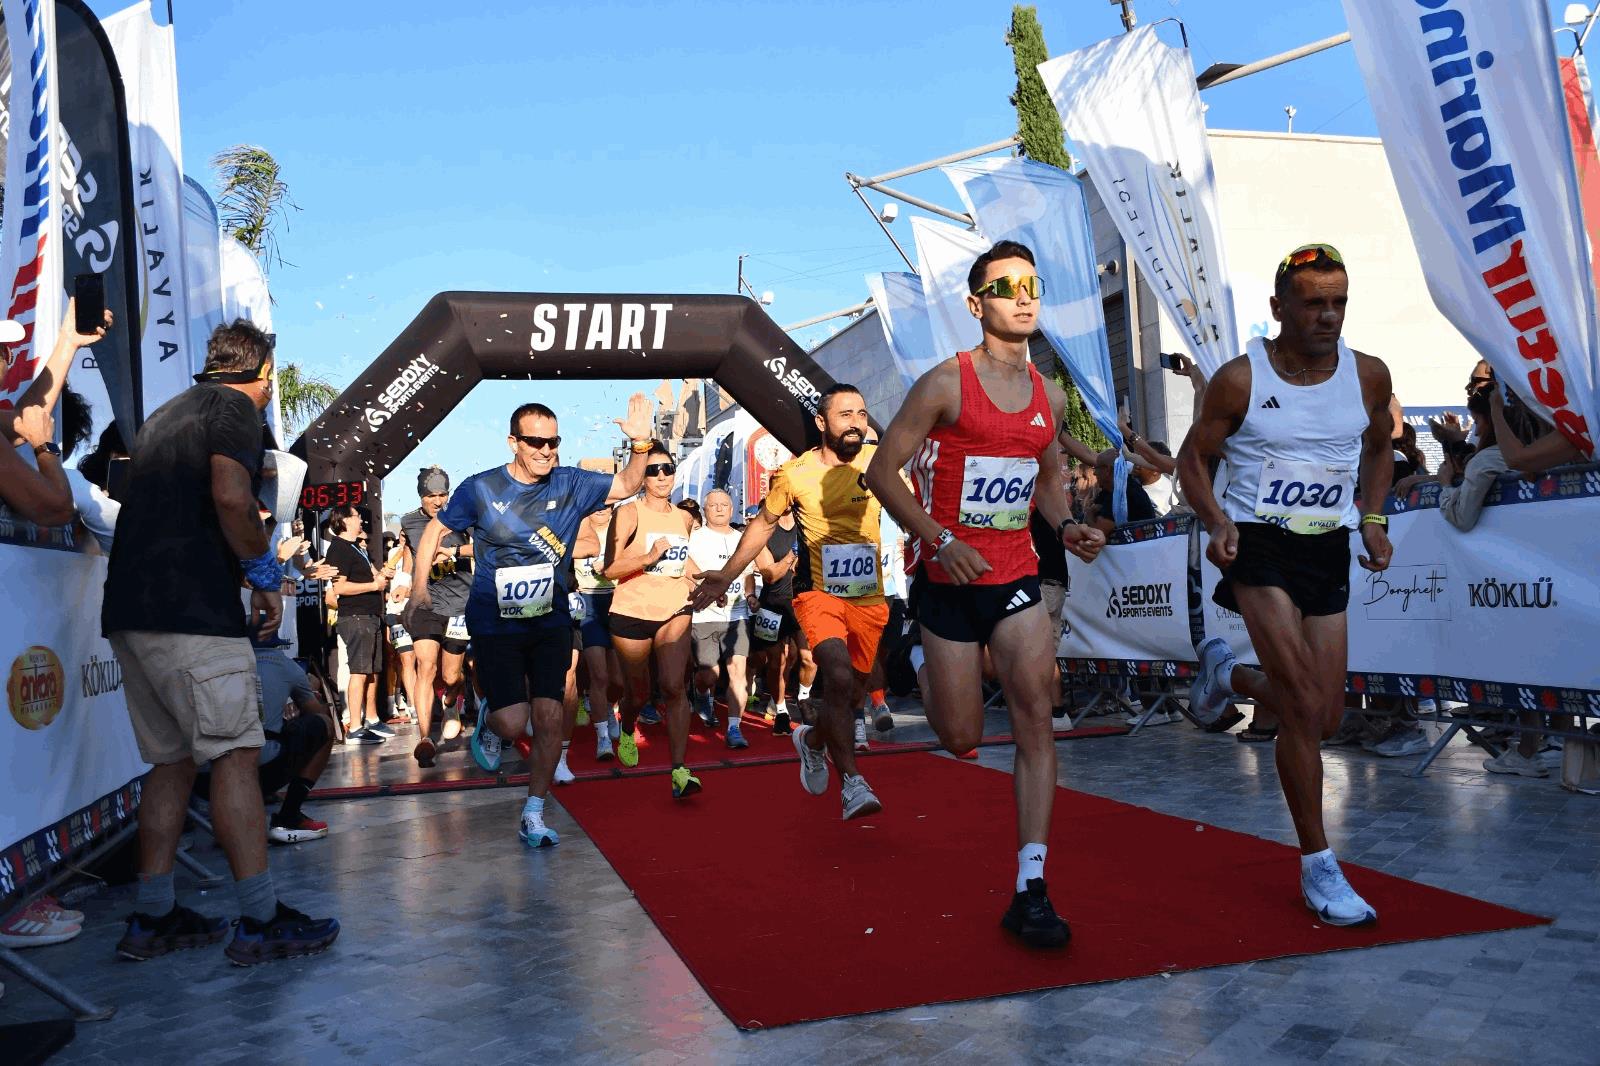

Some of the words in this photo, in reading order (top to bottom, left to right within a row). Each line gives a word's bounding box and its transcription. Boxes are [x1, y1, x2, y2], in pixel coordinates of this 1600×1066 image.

[530, 303, 674, 351] START
[377, 353, 432, 408] SEDOXY
[388, 386, 417, 415] SPORTS
[412, 363, 440, 391] EVENTS
[780, 377, 806, 403] SPORTS
[302, 481, 363, 509] 06:33
[966, 477, 1034, 504] 1064
[1262, 479, 1343, 508] 1030
[960, 512, 996, 526] 10K
[1308, 520, 1338, 529] AYVALIK
[827, 556, 874, 578] 1108
[502, 577, 552, 601] 1077
[826, 584, 850, 594] 10K
[1121, 583, 1172, 606] SEDOXY
[1467, 577, 1555, 608] KÖKLÜ
[502, 606, 524, 616] 10K
[1122, 607, 1147, 618] SPORTS
[1147, 605, 1173, 617] EVENTS
